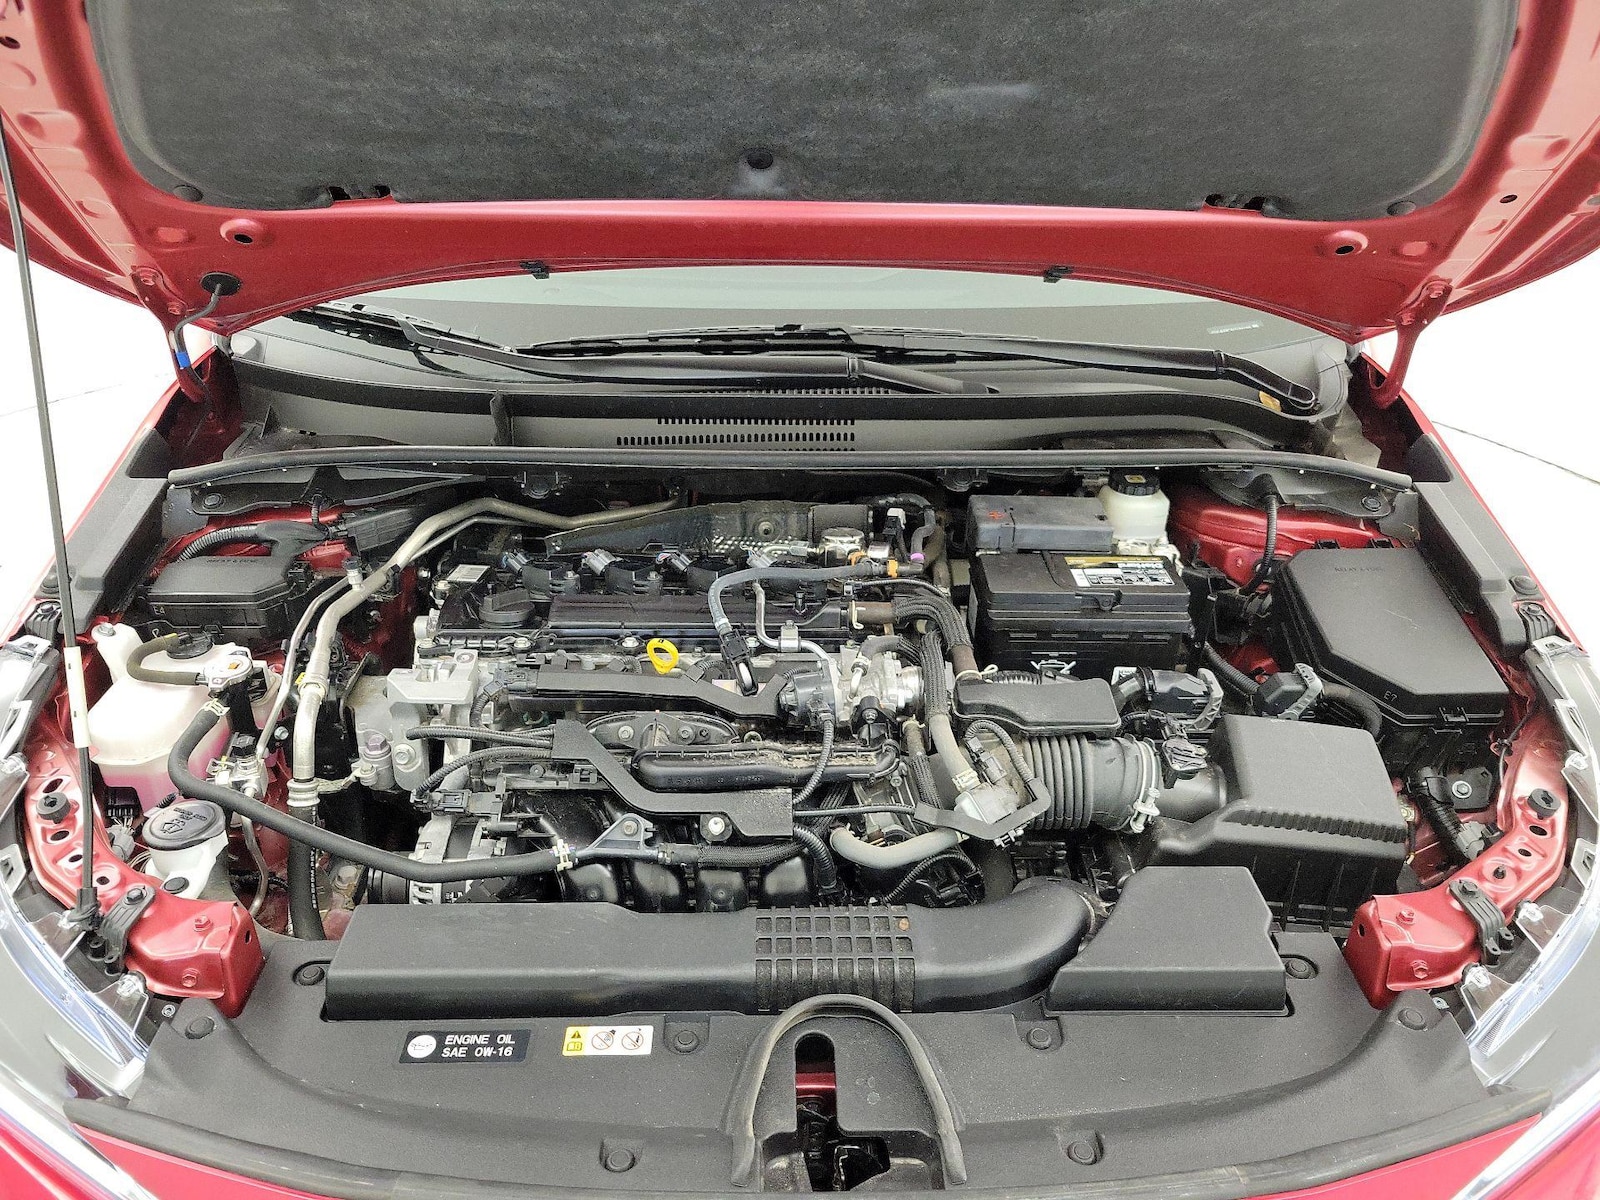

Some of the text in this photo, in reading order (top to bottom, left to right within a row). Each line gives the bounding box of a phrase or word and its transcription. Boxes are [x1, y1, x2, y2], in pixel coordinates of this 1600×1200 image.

[1383, 690, 1398, 702] E7
[444, 1034, 516, 1045] ENGINE OIL
[441, 1046, 513, 1058] SAE 0W-16
